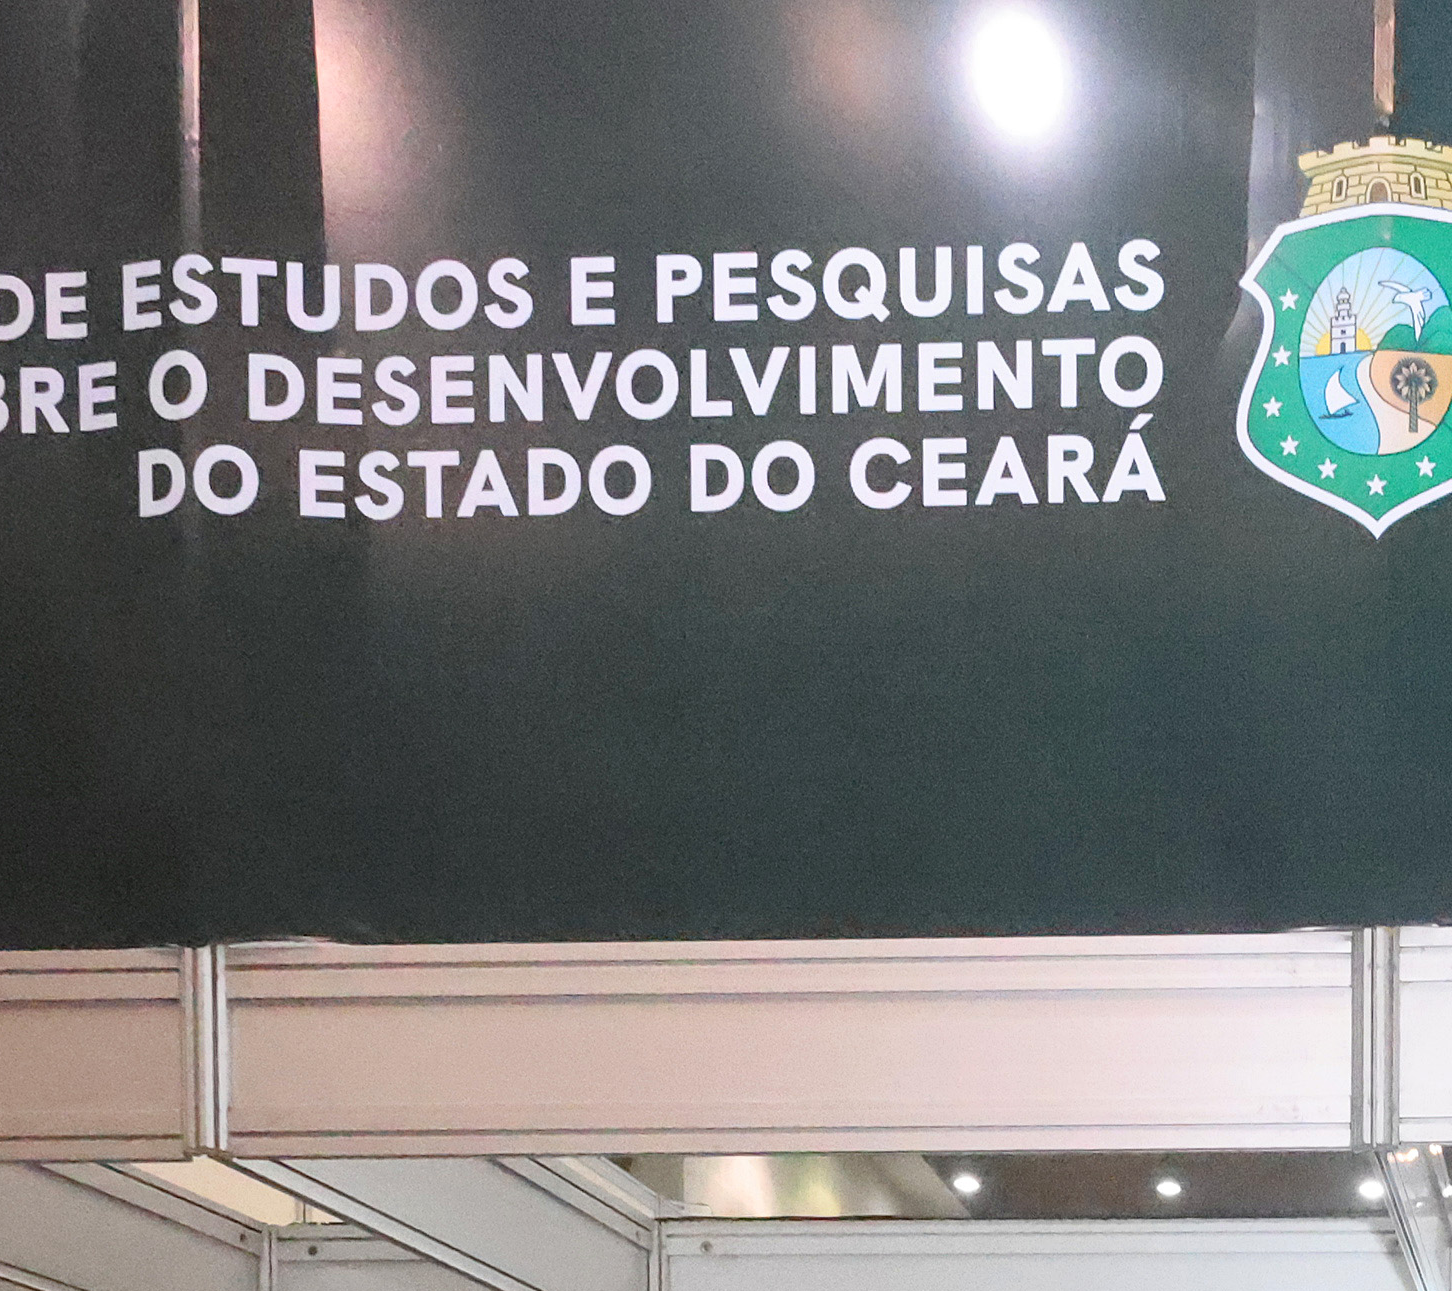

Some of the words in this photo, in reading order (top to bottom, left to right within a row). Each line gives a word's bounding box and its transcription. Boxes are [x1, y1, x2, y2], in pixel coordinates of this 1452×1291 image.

[123, 253, 533, 333] ESTUDOS
[570, 255, 616, 326] E
[657, 239, 1165, 324] PESQUISAS
[149, 349, 208, 421] O
[248, 336, 1164, 426] DESENVOLVIMENTO
[138, 445, 260, 519] DO
[300, 445, 652, 520] ESTADO
[690, 440, 815, 513] DO
[850, 414, 1166, 508] CEARÁ
